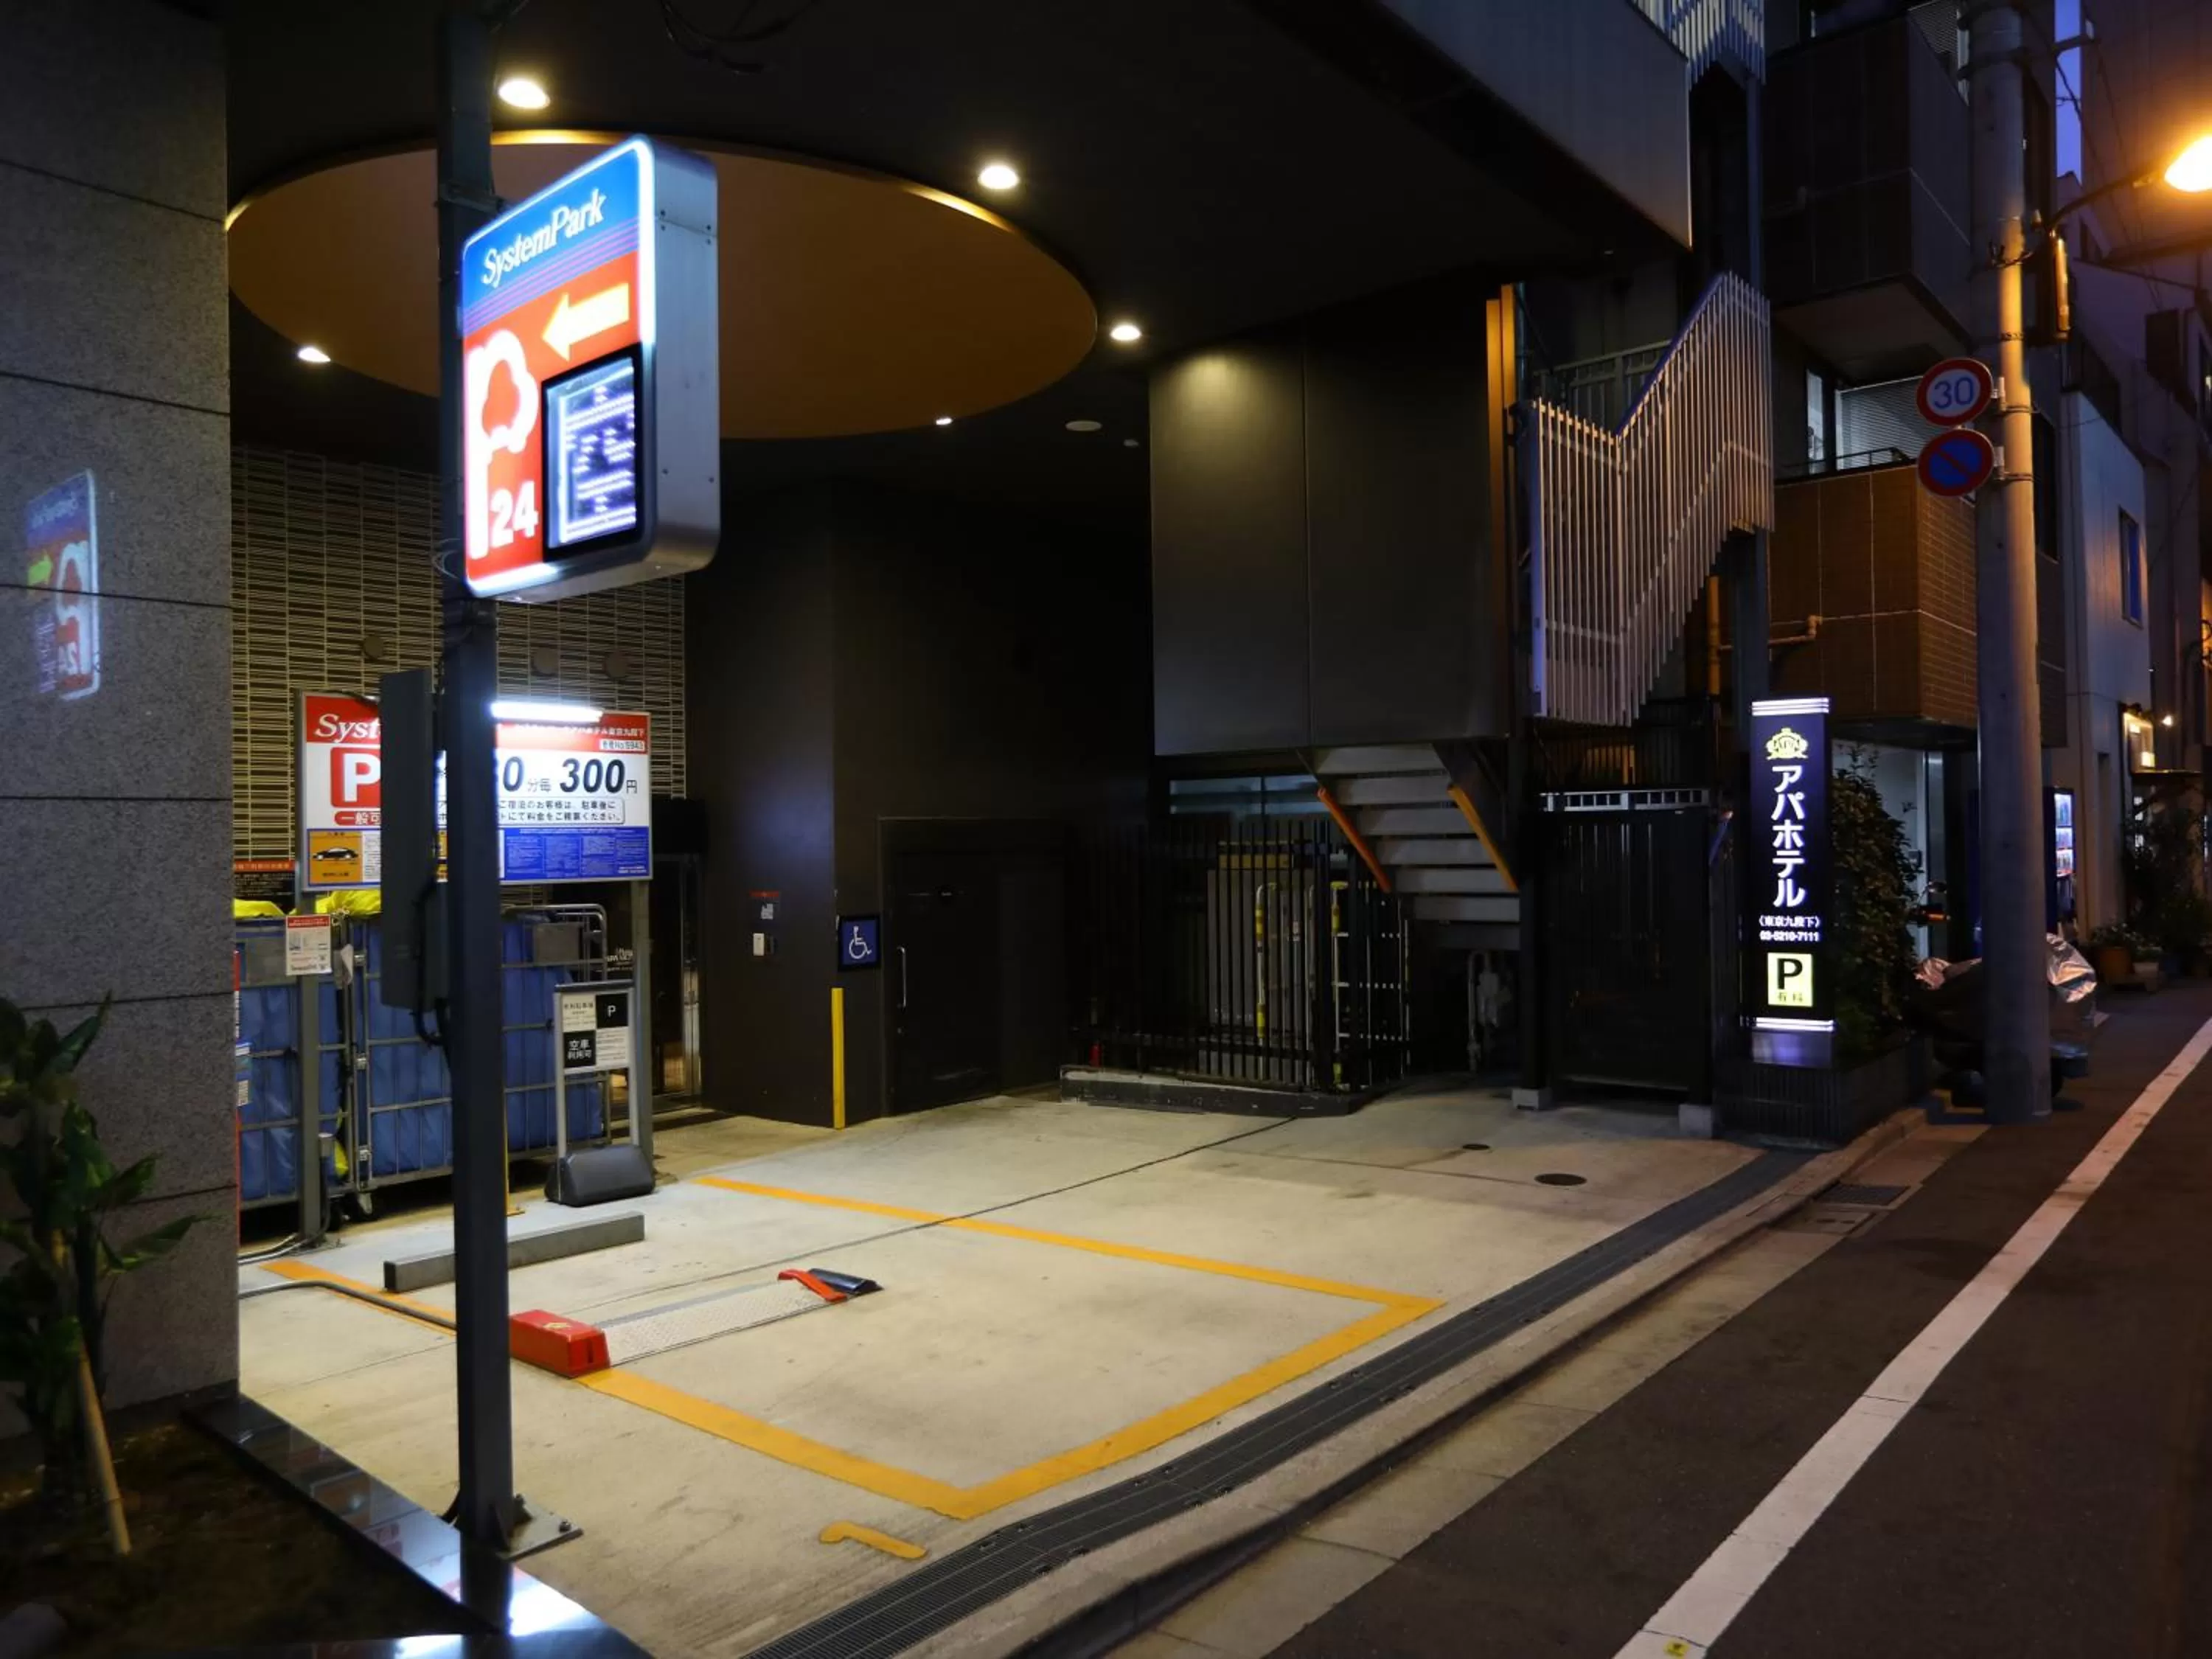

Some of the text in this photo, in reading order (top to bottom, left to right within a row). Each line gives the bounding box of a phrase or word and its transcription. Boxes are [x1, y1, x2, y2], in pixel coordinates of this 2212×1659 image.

[481, 188, 608, 288] SystemPark
[1934, 377, 1974, 410] 30
[490, 480, 538, 549] 24
[344, 754, 381, 802] P
[1771, 765, 1806, 908] アパホテル
[1760, 931, 1820, 942] 03-5210-7111
[1777, 958, 1804, 990] P
[607, 1004, 616, 1018] P
